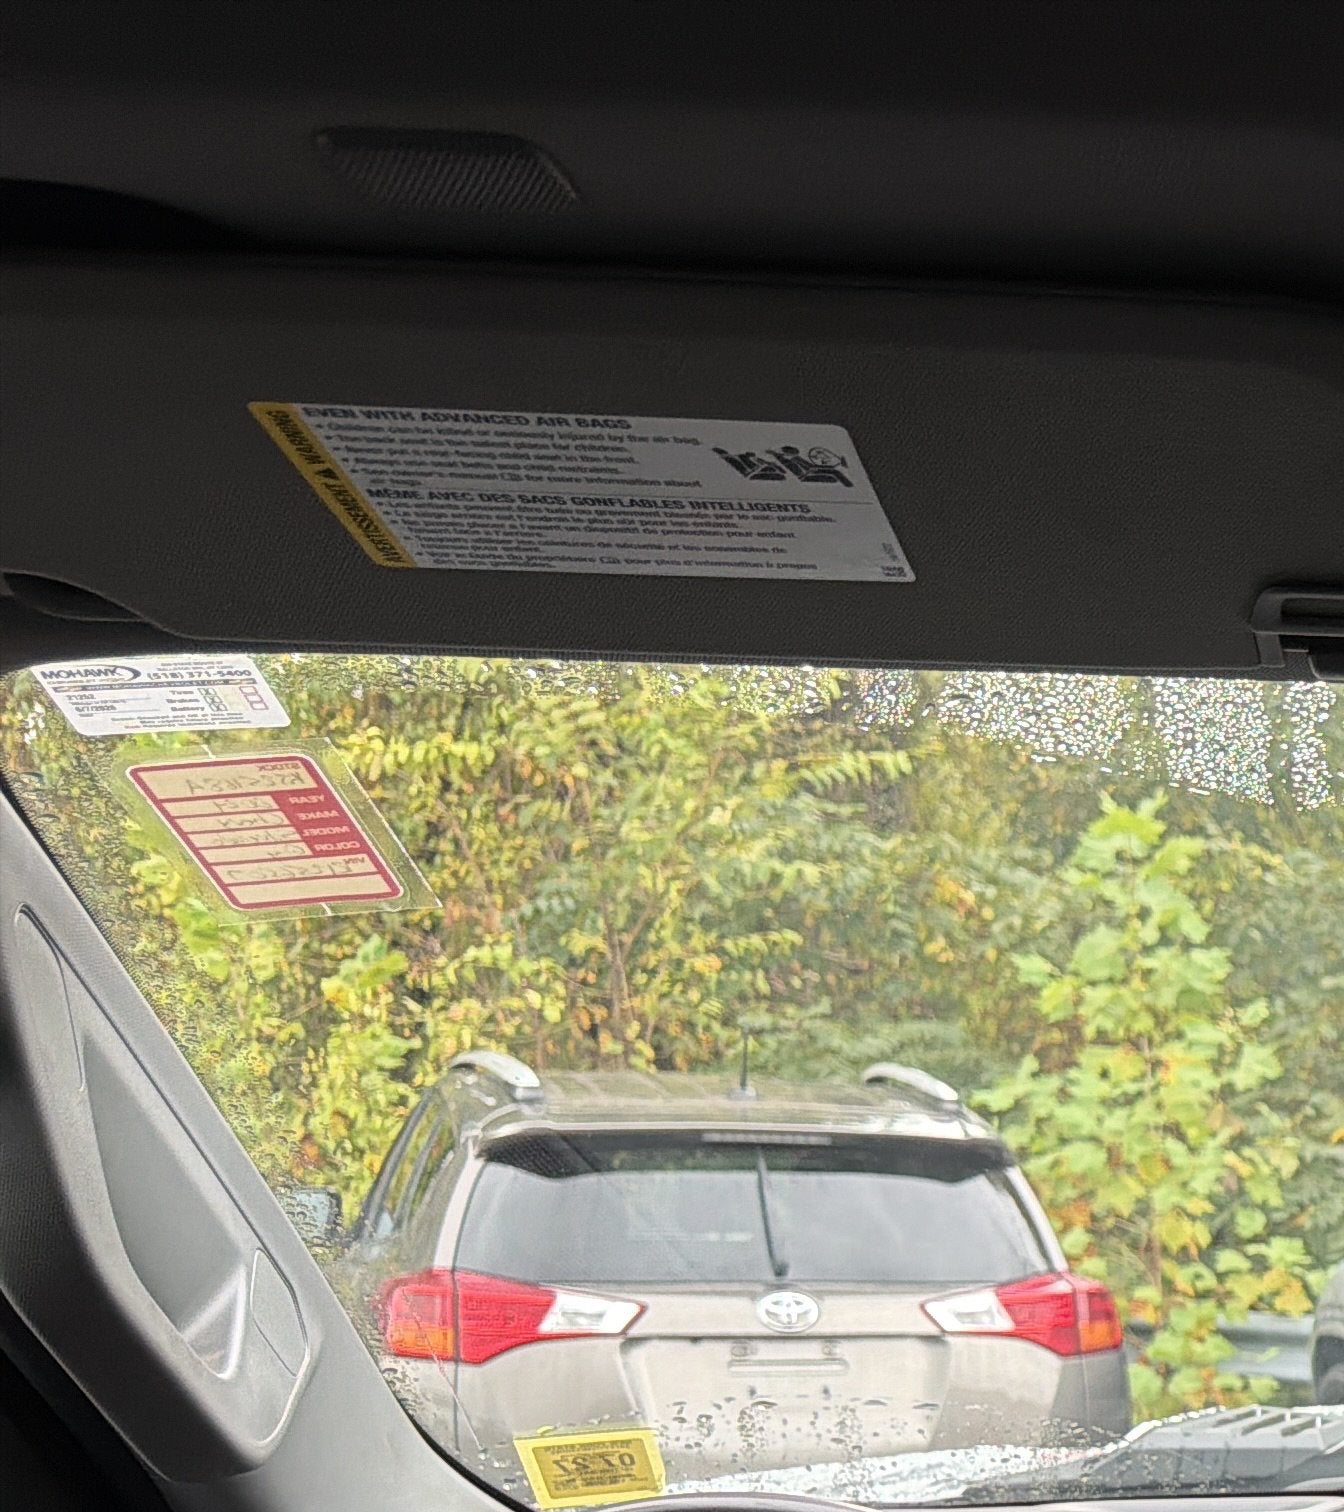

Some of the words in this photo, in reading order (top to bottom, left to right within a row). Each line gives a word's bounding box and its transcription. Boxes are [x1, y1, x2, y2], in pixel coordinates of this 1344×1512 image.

[359, 409, 415, 421] WITH
[421, 412, 530, 426] ADVANCED
[536, 416, 571, 428] AIR
[575, 417, 632, 429] BAGS
[40, 667, 121, 679] MOHAWK
